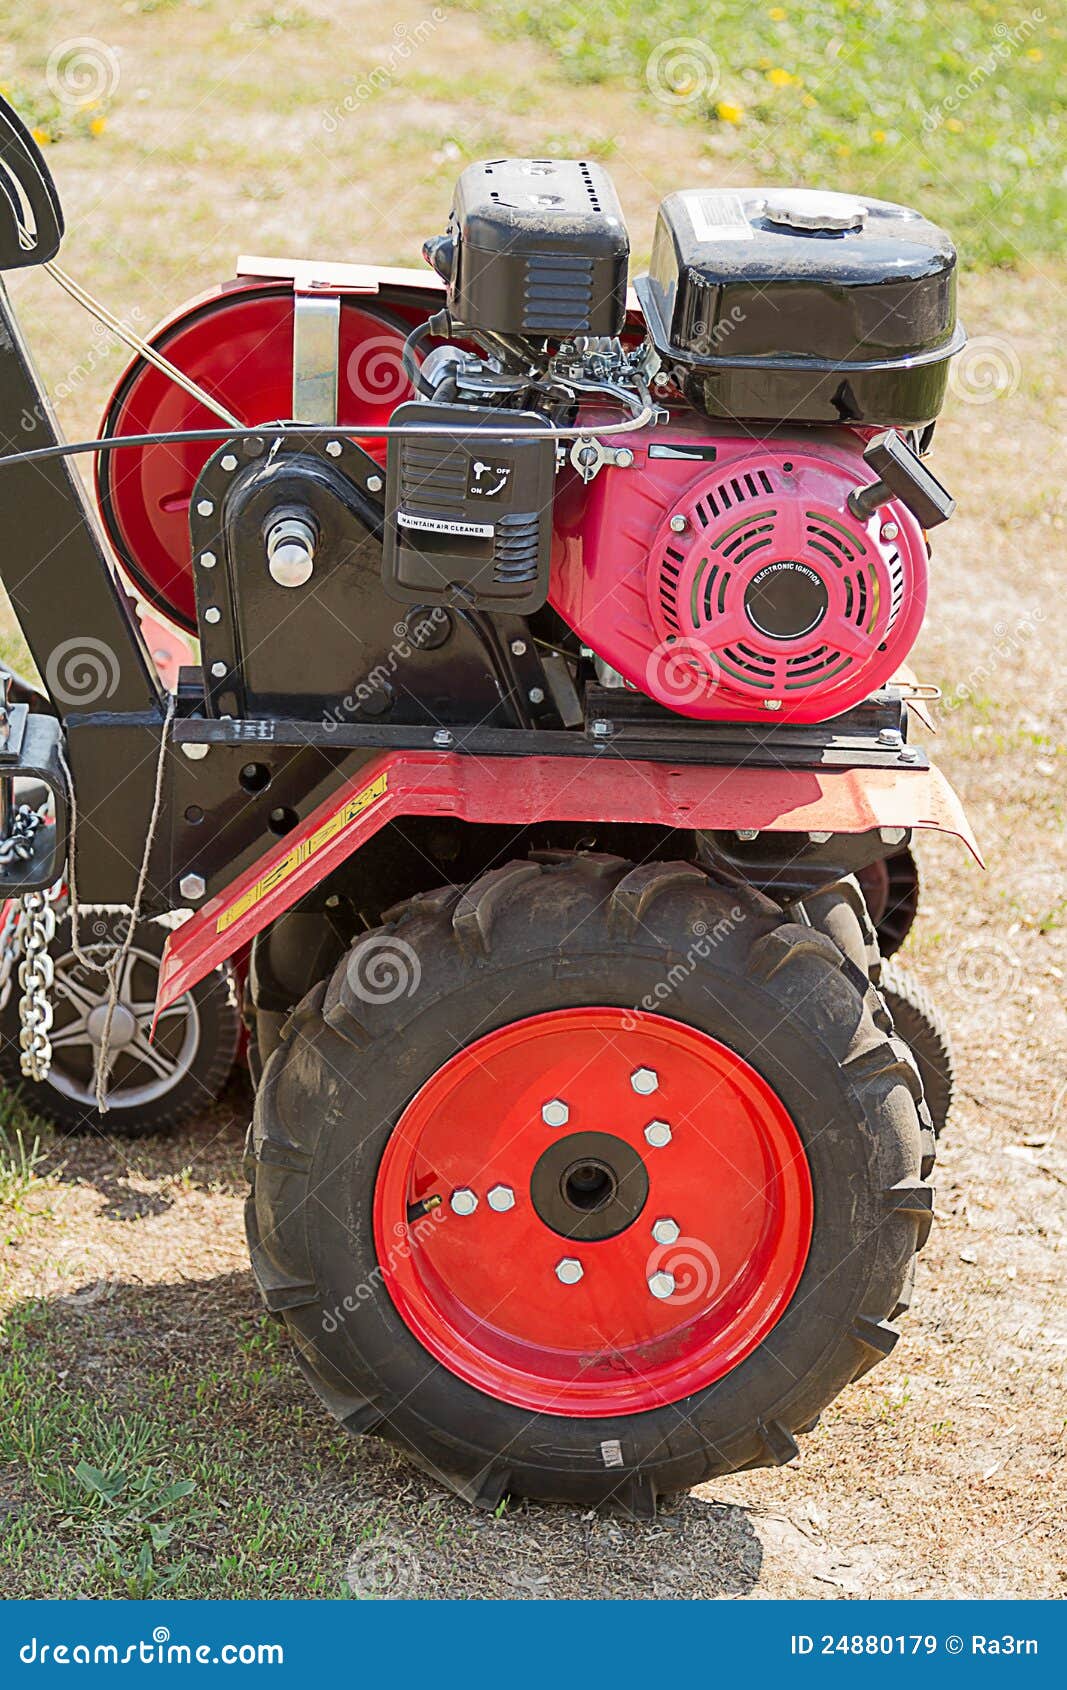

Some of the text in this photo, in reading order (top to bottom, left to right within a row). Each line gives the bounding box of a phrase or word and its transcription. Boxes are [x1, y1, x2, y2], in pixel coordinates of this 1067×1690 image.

[470, 487, 482, 495] ON
[401, 517, 484, 534] MAINTAIN AIR CLEANER
[753, 563, 821, 586] ELECTRONIC IGNITION
